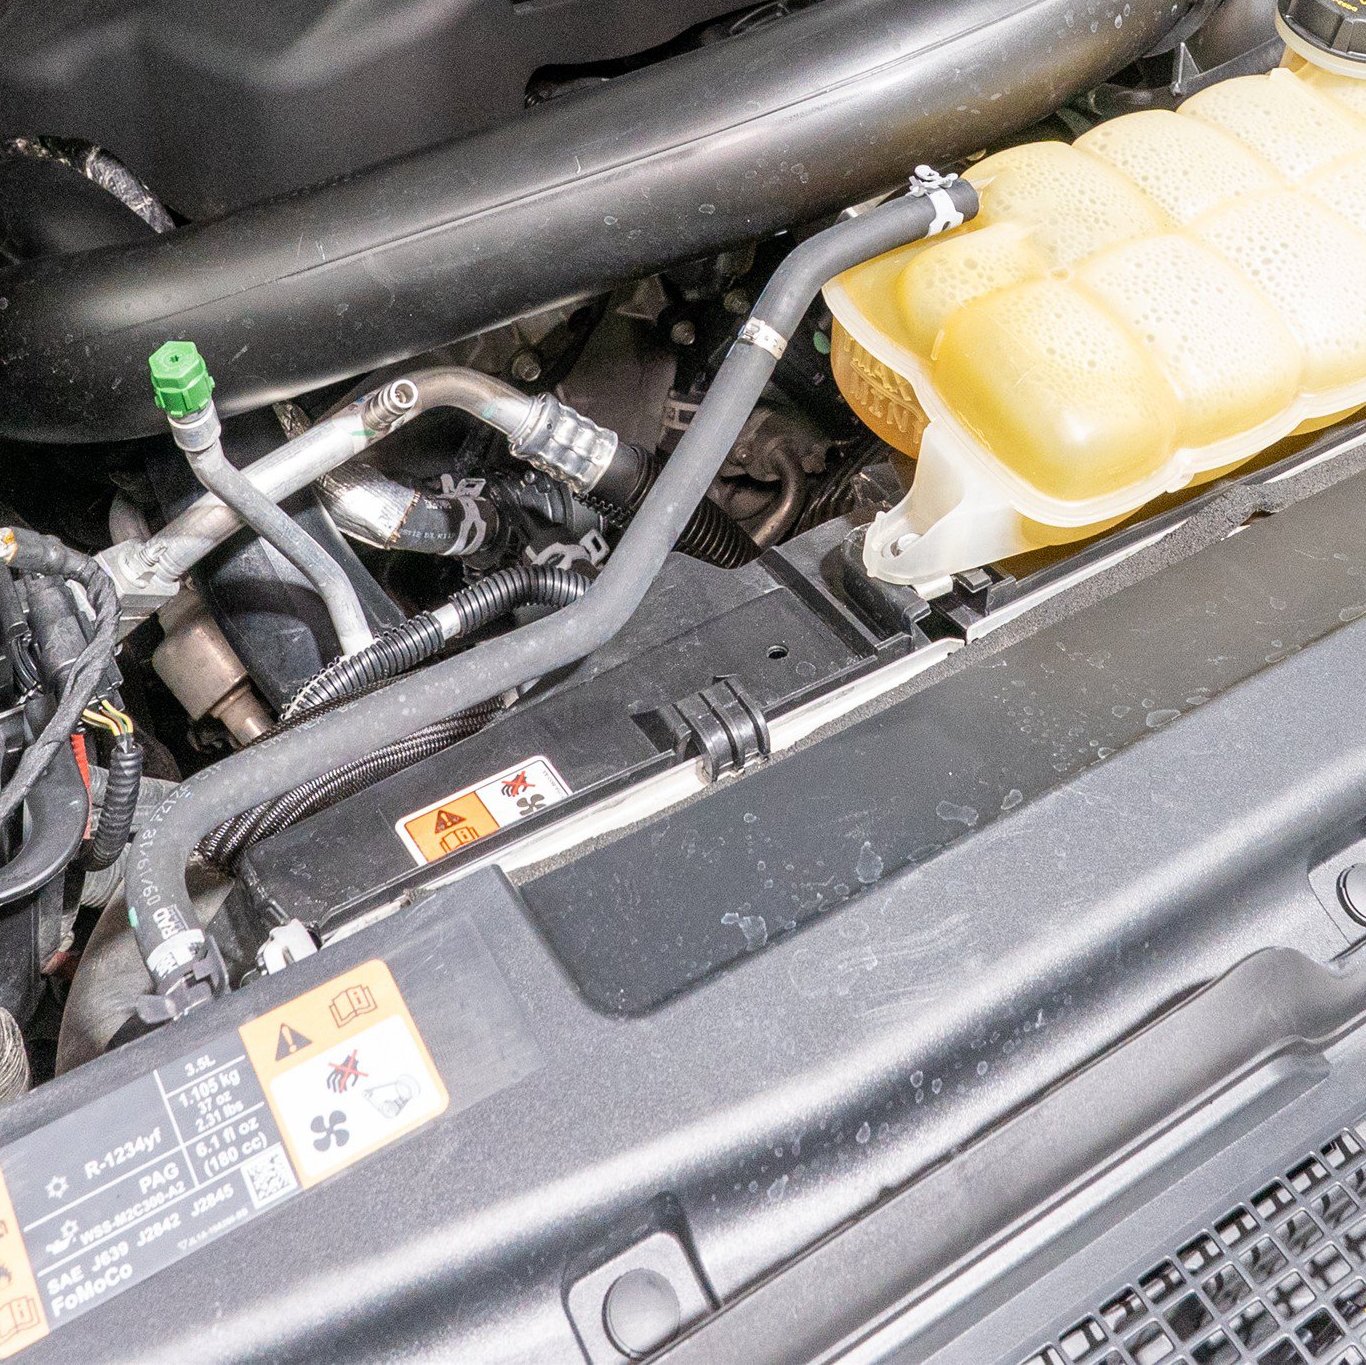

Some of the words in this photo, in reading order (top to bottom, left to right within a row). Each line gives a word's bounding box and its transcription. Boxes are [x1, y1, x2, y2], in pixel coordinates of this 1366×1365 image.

[184, 1054, 216, 1077] 3.5L
[178, 1077, 219, 1108] 1.105
[218, 1069, 241, 1088] kg
[197, 1096, 212, 1115] 37
[215, 1090, 232, 1106] oz
[195, 1109, 222, 1133] 2.31
[222, 1100, 244, 1118] lbs
[84, 1126, 162, 1180] R-1234yf
[195, 1134, 220, 1158] 6.1
[222, 1126, 236, 1144] fl
[238, 1117, 259, 1135] oz
[203, 1146, 239, 1178] (180
[241, 1131, 268, 1155] cc)
[138, 1162, 180, 1195] PAG
[47, 1264, 84, 1295] SAE
[91, 1241, 129, 1272] J639
[136, 1212, 182, 1247] J2842
[190, 1183, 234, 1217] J2845
[51, 1263, 133, 1318] FoMoCo
